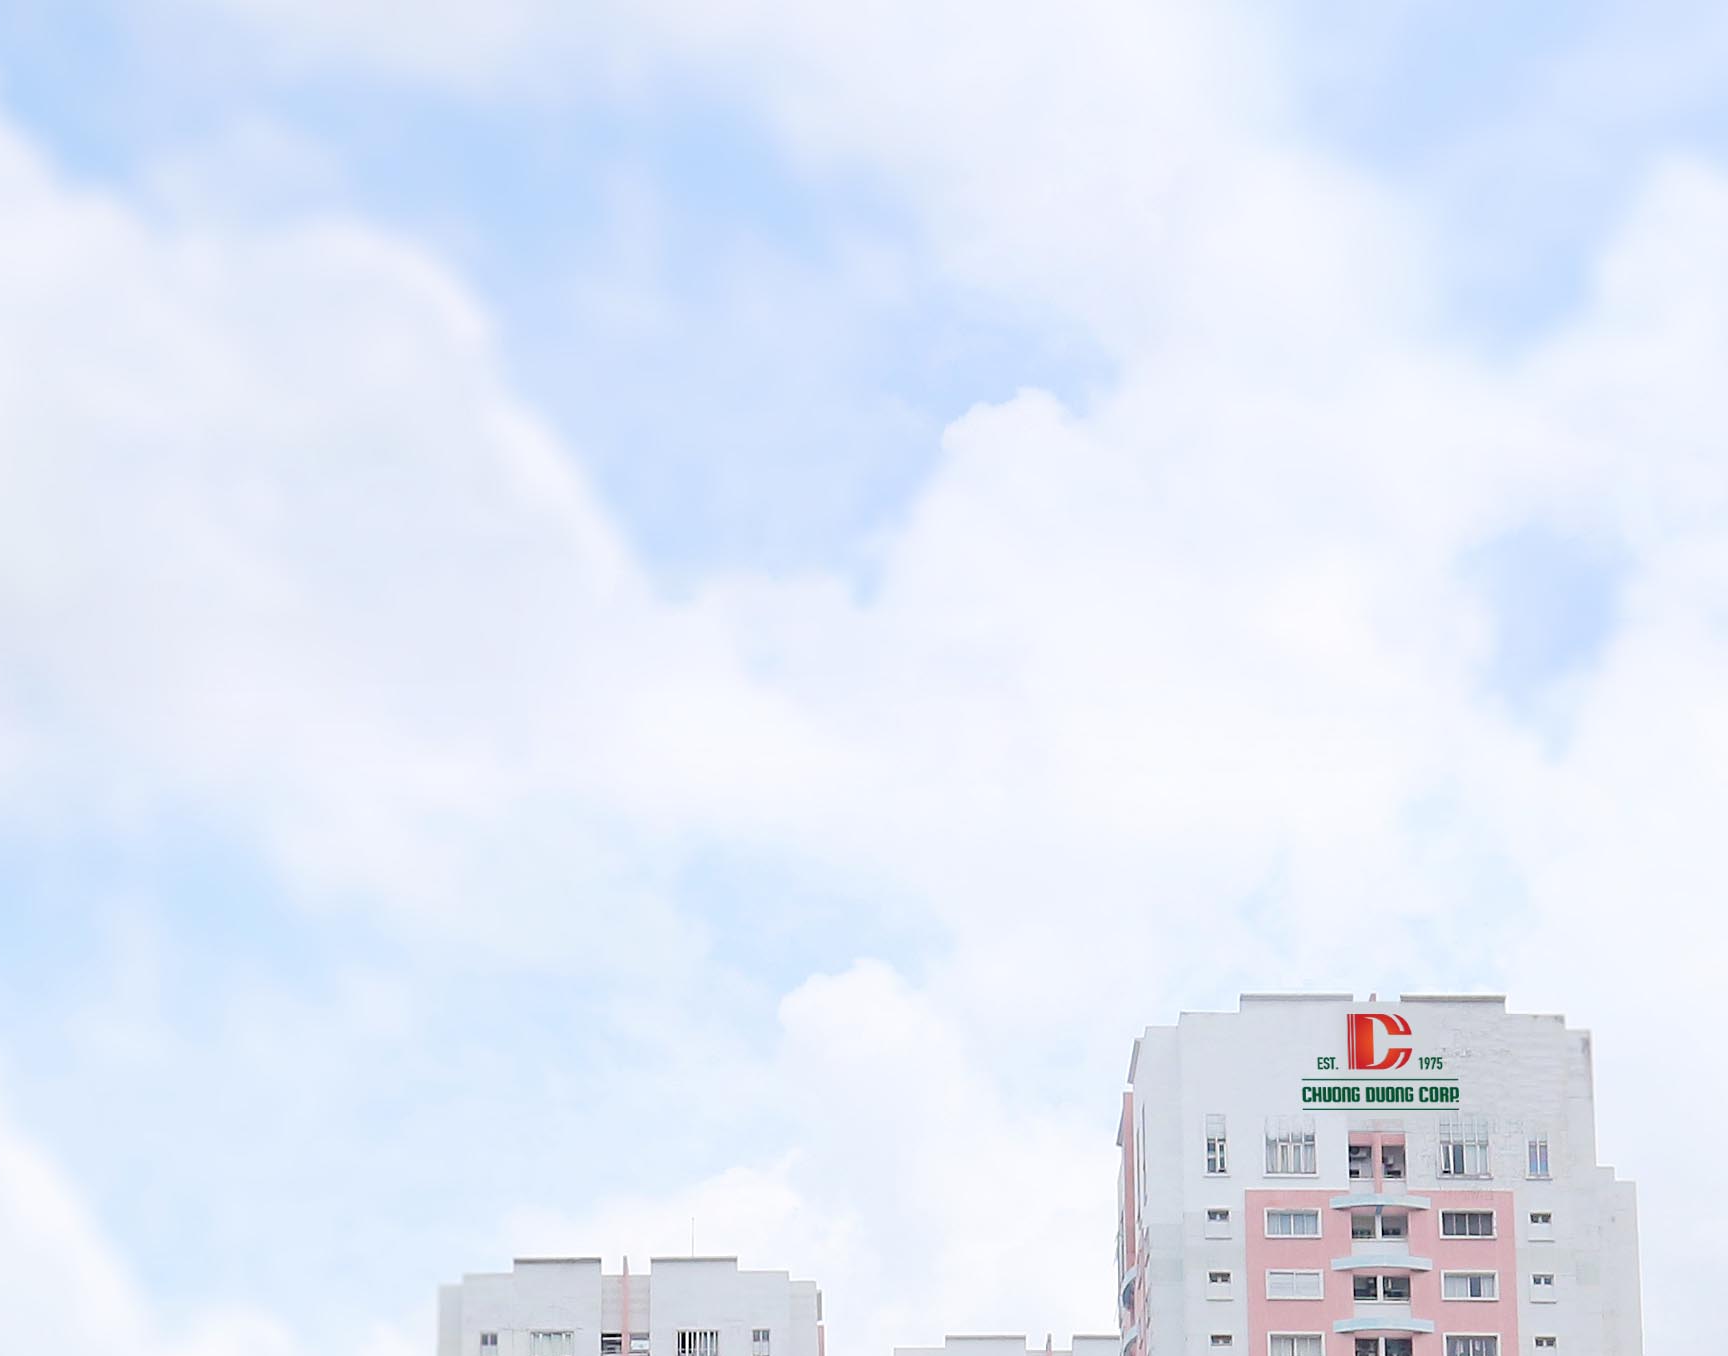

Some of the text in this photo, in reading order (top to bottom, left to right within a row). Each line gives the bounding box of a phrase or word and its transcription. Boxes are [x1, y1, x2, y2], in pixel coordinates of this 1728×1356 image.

[1317, 1056, 1339, 1070] EST.
[1418, 1056, 1443, 1070] 1975
[1302, 1086, 1360, 1103] CHUONG
[1365, 1086, 1414, 1103] DUONG
